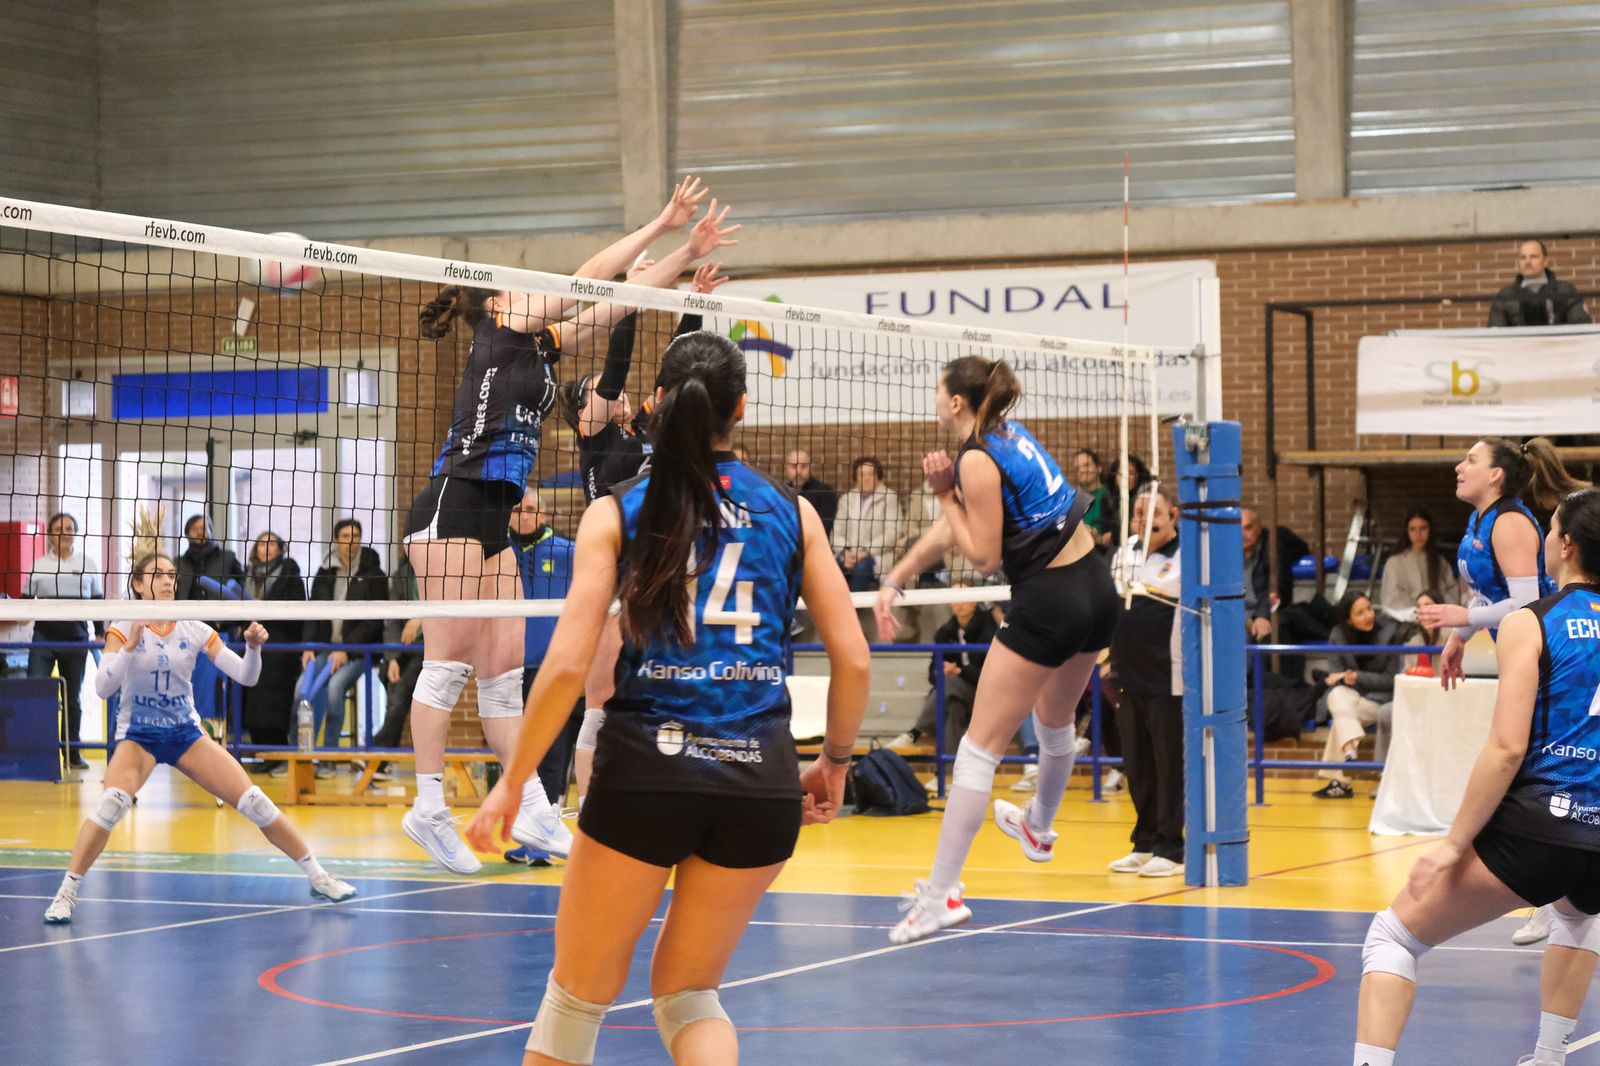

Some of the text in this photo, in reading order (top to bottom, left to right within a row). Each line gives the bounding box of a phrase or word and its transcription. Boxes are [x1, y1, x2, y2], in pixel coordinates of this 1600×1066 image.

[144, 221, 206, 244] rfevb.com
[303, 244, 358, 265] rfevb.com
[444, 264, 493, 282] rfevb.com
[570, 280, 614, 297] rfevb.com
[684, 294, 723, 312] rfevb.com
[865, 283, 1129, 316] FUNDAL
[785, 306, 821, 323] rfevb.com
[878, 320, 911, 334] rfevb.com
[1017, 435, 1064, 496] 2
[150, 669, 171, 692] 11
[709, 661, 782, 685] Coliving
[1542, 741, 1597, 760] Kanso
